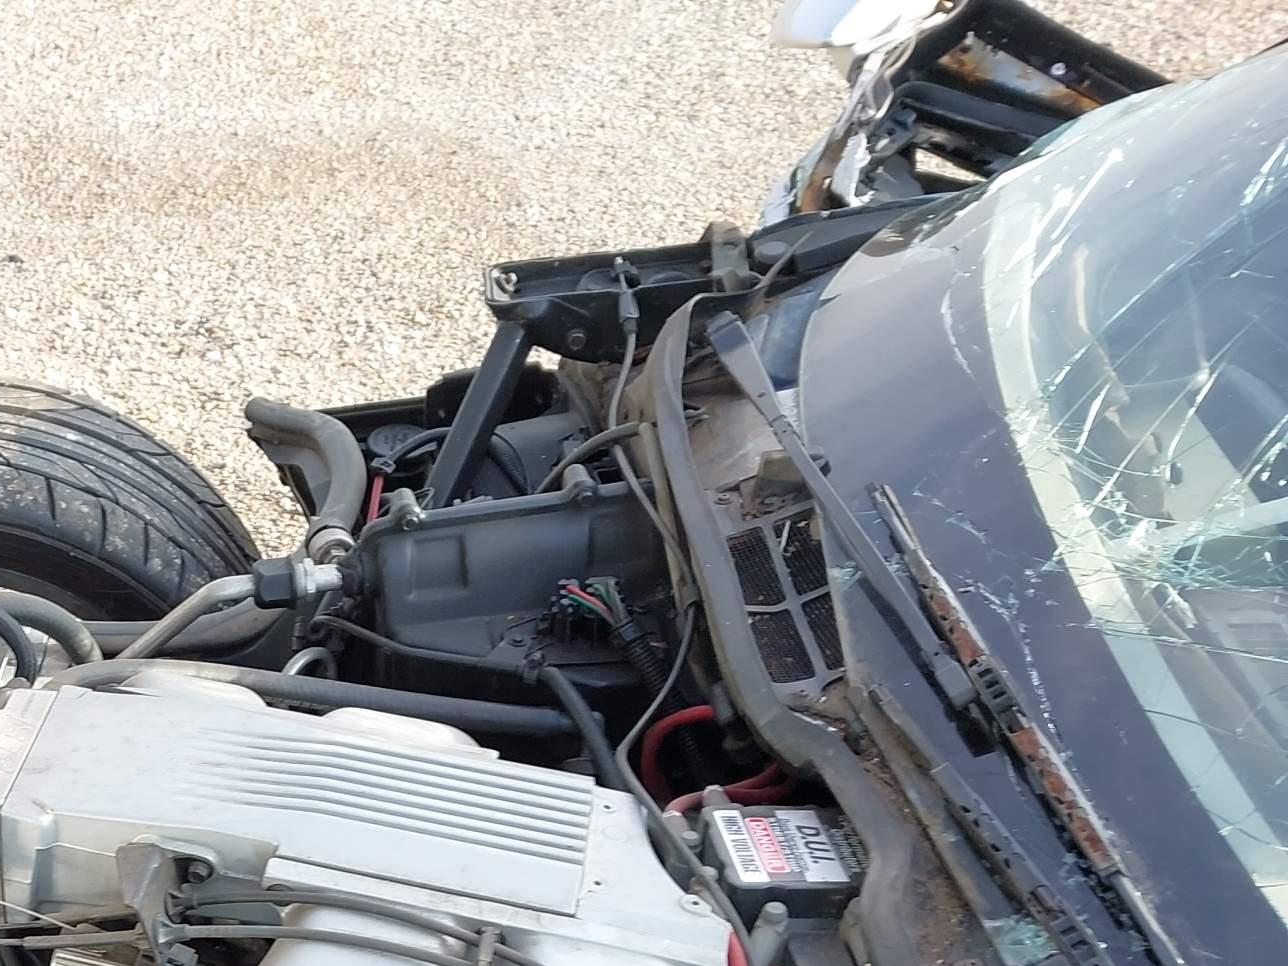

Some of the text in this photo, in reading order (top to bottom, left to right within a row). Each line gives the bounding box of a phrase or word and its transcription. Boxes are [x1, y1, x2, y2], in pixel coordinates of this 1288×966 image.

[720, 815, 761, 873] HIGH VOLTAGE
[750, 822, 786, 867] DANGER
[794, 824, 836, 864] D.U.I.
